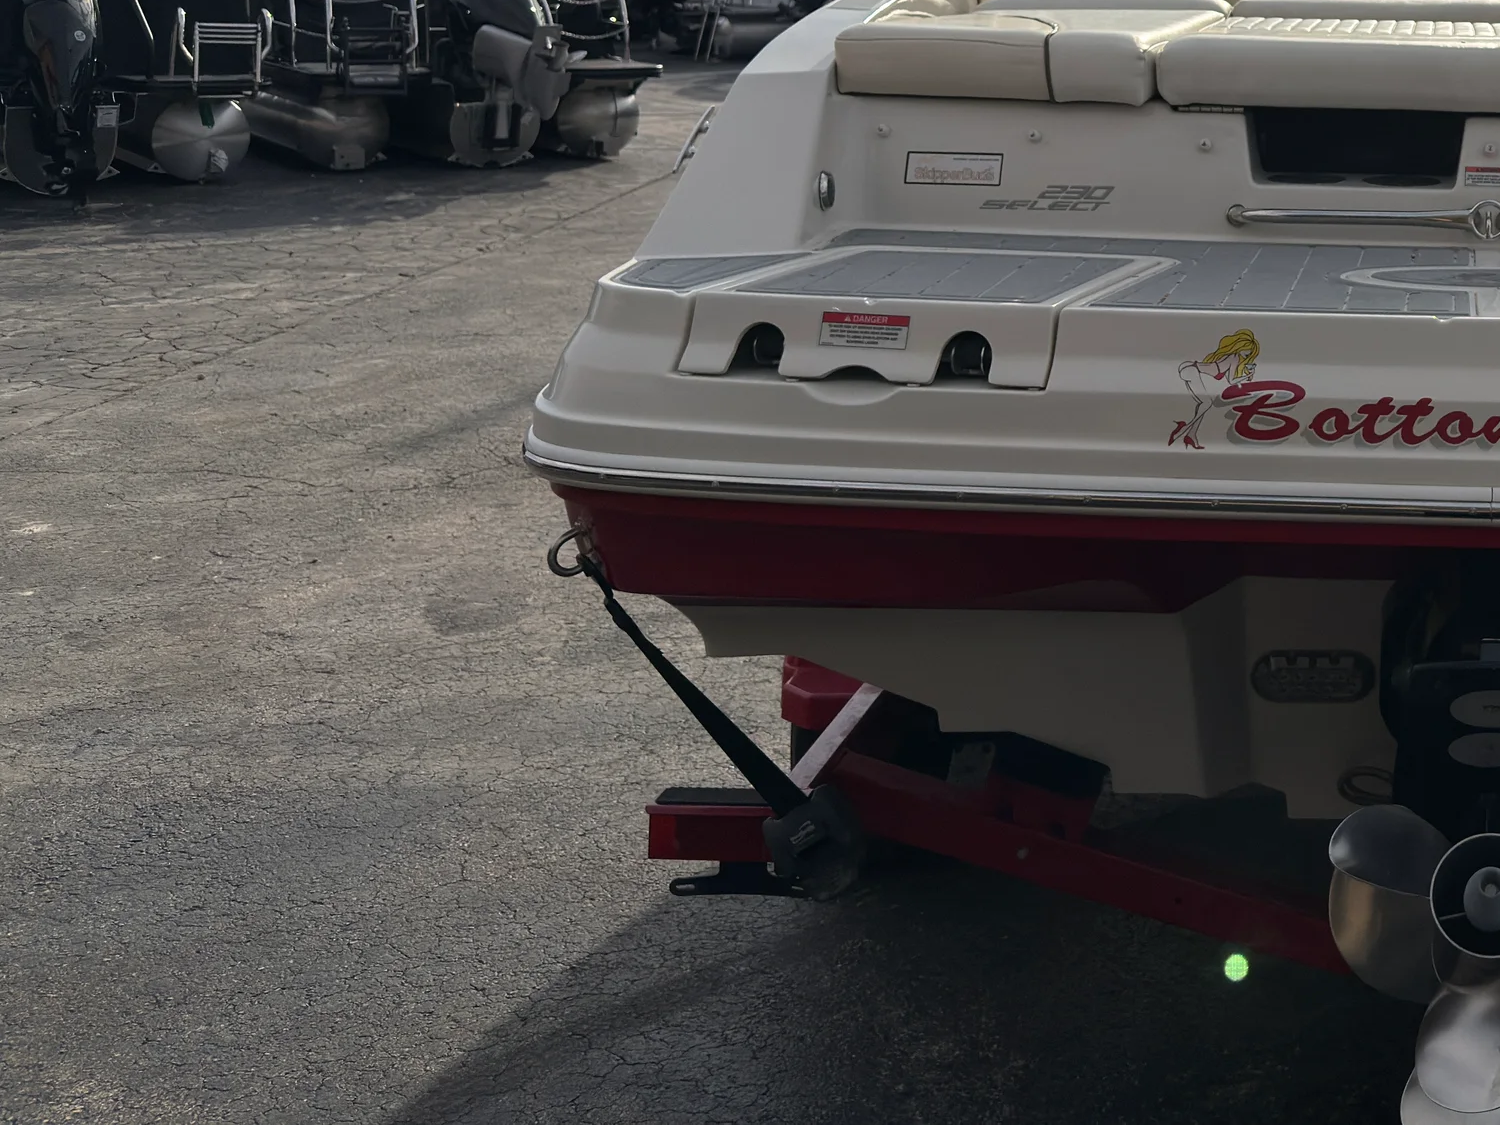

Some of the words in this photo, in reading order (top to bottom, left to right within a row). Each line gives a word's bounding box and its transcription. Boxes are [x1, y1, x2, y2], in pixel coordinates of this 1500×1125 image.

[1037, 184, 1116, 200] 230
[979, 199, 1111, 212] SELECT
[853, 315, 888, 324] DANGER
